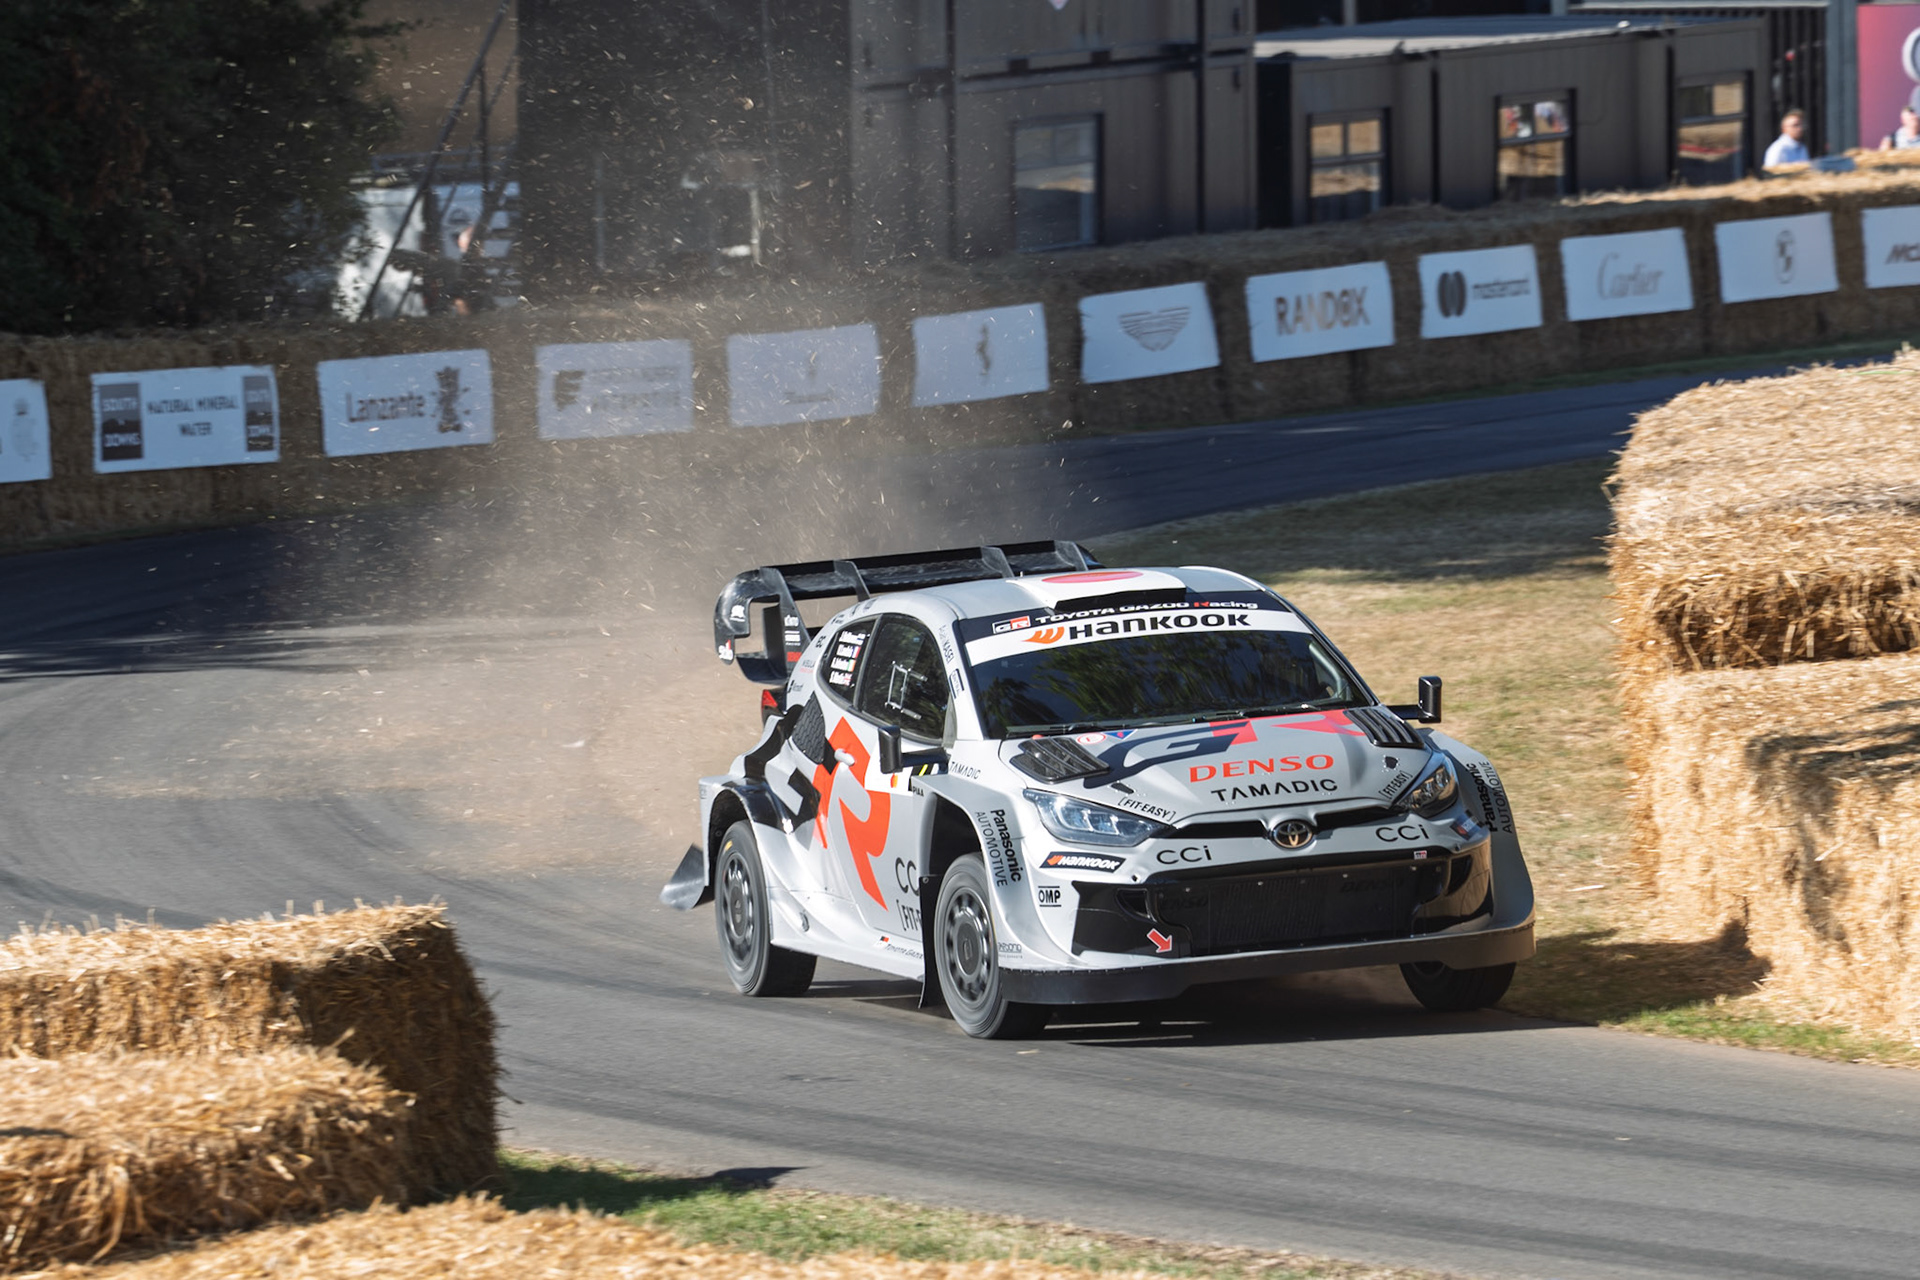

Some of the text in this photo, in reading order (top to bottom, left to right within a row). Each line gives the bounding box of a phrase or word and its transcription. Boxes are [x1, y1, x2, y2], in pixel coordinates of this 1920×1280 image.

[1035, 607, 1115, 624] TOYOTA
[1119, 601, 1190, 613] GAZOO
[949, 761, 981, 780] TAMADIC
[1189, 754, 1335, 783] DENSO
[1211, 778, 1338, 802] TAMADIC
[1466, 763, 1498, 832] Panasonic
[1479, 761, 1513, 834] AUTOMOTIVE
[975, 811, 1008, 887] AUTOMOTIVE
[990, 808, 1023, 883] Panasonic
[1038, 889, 1061, 904] OMP
